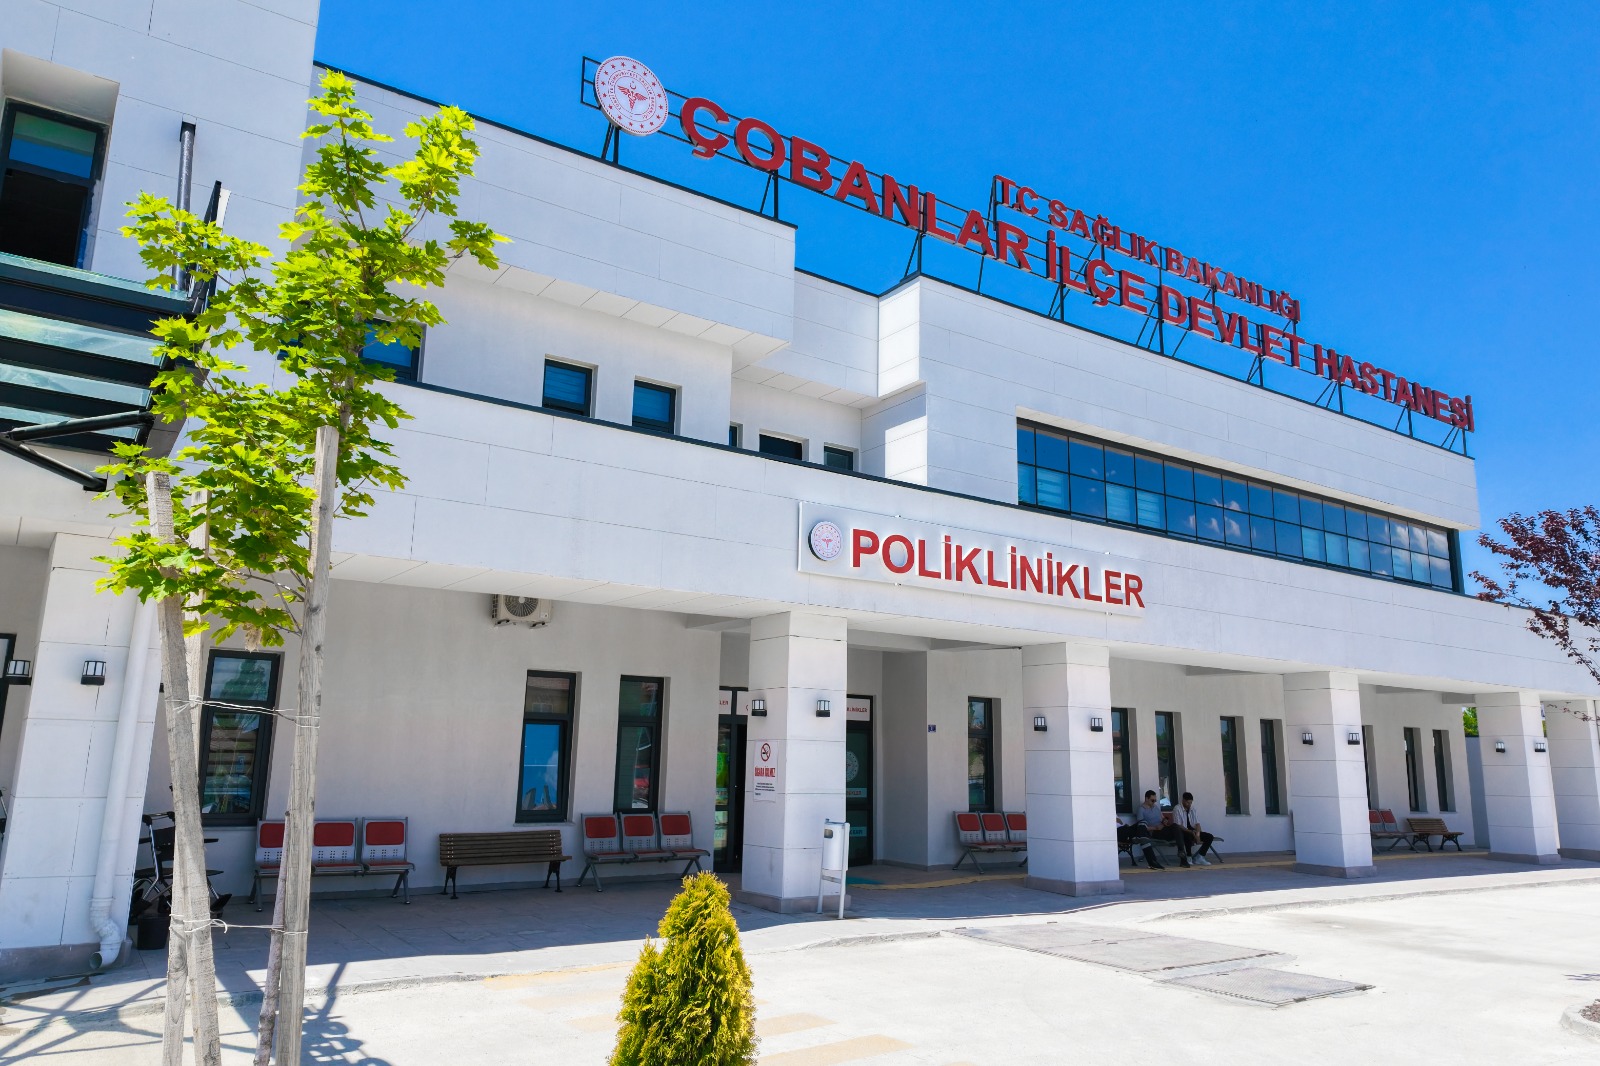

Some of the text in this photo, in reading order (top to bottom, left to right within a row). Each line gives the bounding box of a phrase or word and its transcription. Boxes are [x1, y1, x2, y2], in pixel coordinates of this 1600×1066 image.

[680, 97, 1475, 433] ÇOBANLAR İLÇE DEVLET HASTANESİ
[1048, 199, 1161, 268] SAĞLIK
[1165, 246, 1301, 322] BAKANLIĞI
[852, 528, 1146, 609] POLİKLİNİKLER
